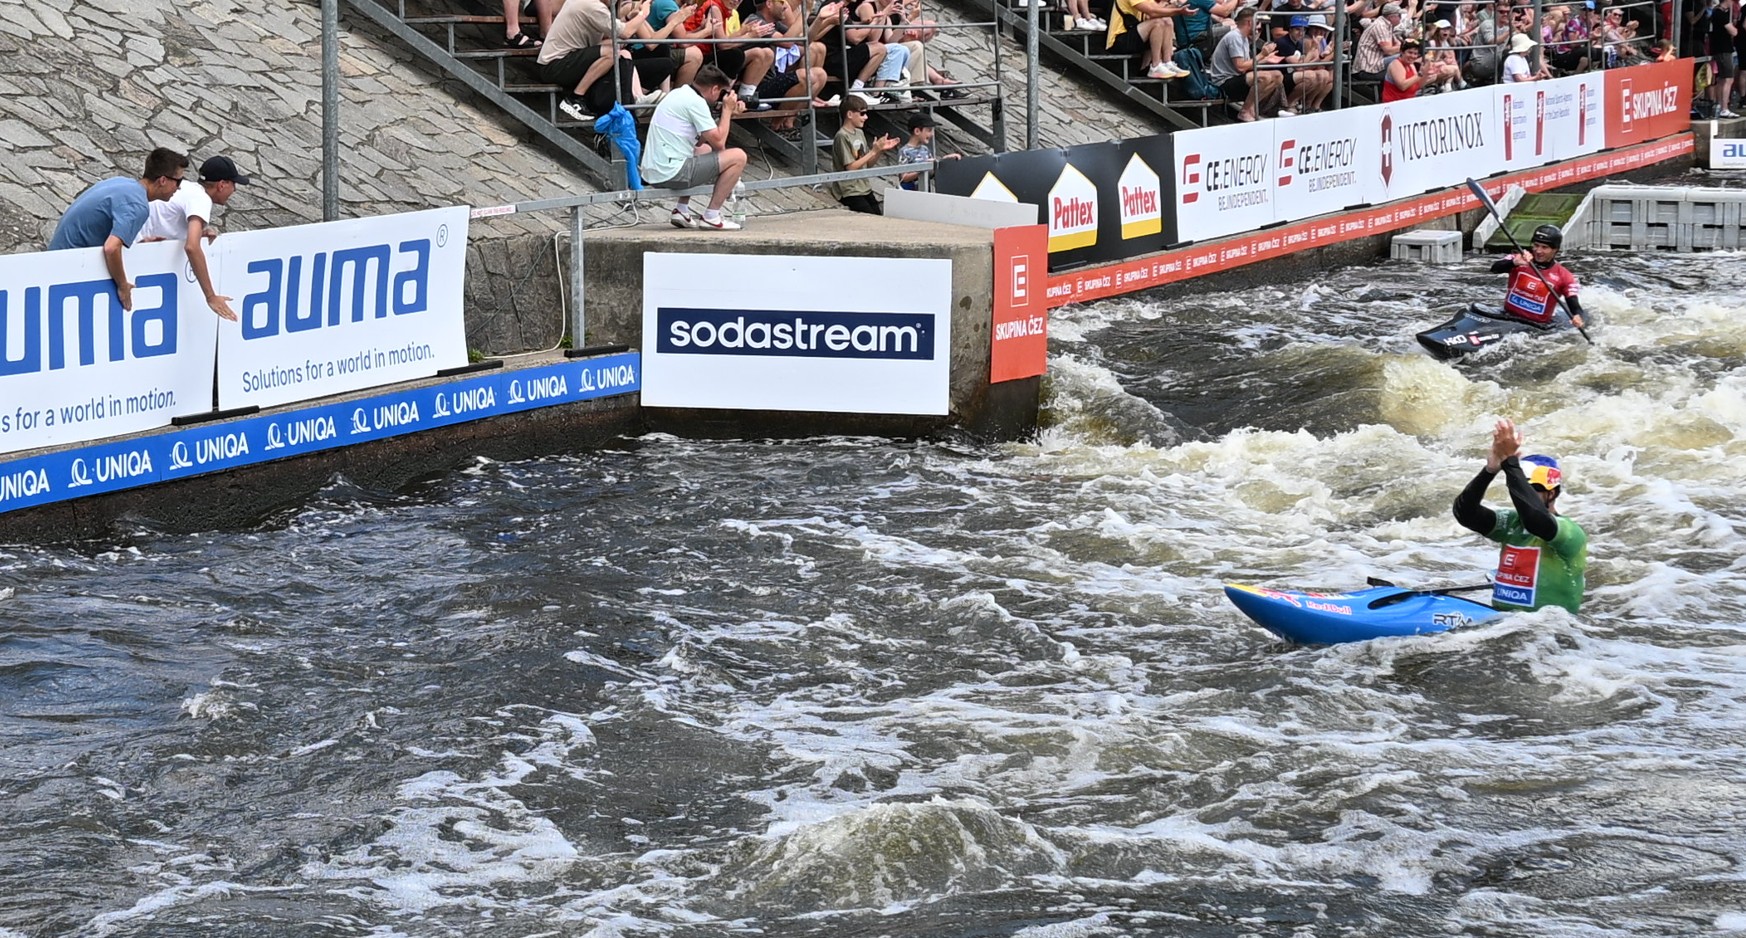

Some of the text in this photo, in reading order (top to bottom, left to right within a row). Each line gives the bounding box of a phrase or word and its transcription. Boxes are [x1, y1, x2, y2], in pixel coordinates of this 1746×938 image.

[1633, 89, 1663, 120] SKUPINA
[1663, 80, 1678, 114] ČEZ
[1298, 137, 1357, 175] CE.ENERGY
[1398, 112, 1484, 163] VICTORINOX
[1206, 153, 1268, 192] CE.ENERGY
[1053, 196, 1093, 230] Pattex
[1122, 185, 1157, 217] Pattex
[241, 238, 431, 341] auma
[670, 316, 918, 353] sodastream
[995, 314, 1043, 341] SKUPINA ČEZ
[242, 341, 435, 393] Solutions for a world in motion.
[16, 408, 41, 431] for
[45, 411, 55, 426] a
[59, 396, 105, 421] world
[109, 396, 122, 417] in
[126, 387, 177, 411] motion.
[96, 449, 153, 482] UNIQA
[196, 431, 249, 464] UNIQA
[287, 413, 337, 446] UNIQA
[373, 400, 420, 430] UNIQA
[453, 385, 497, 413] UNIQA
[527, 374, 568, 401] UNIQA
[597, 363, 635, 390] UNIQA
[1496, 587, 1528, 602] UNIQA
